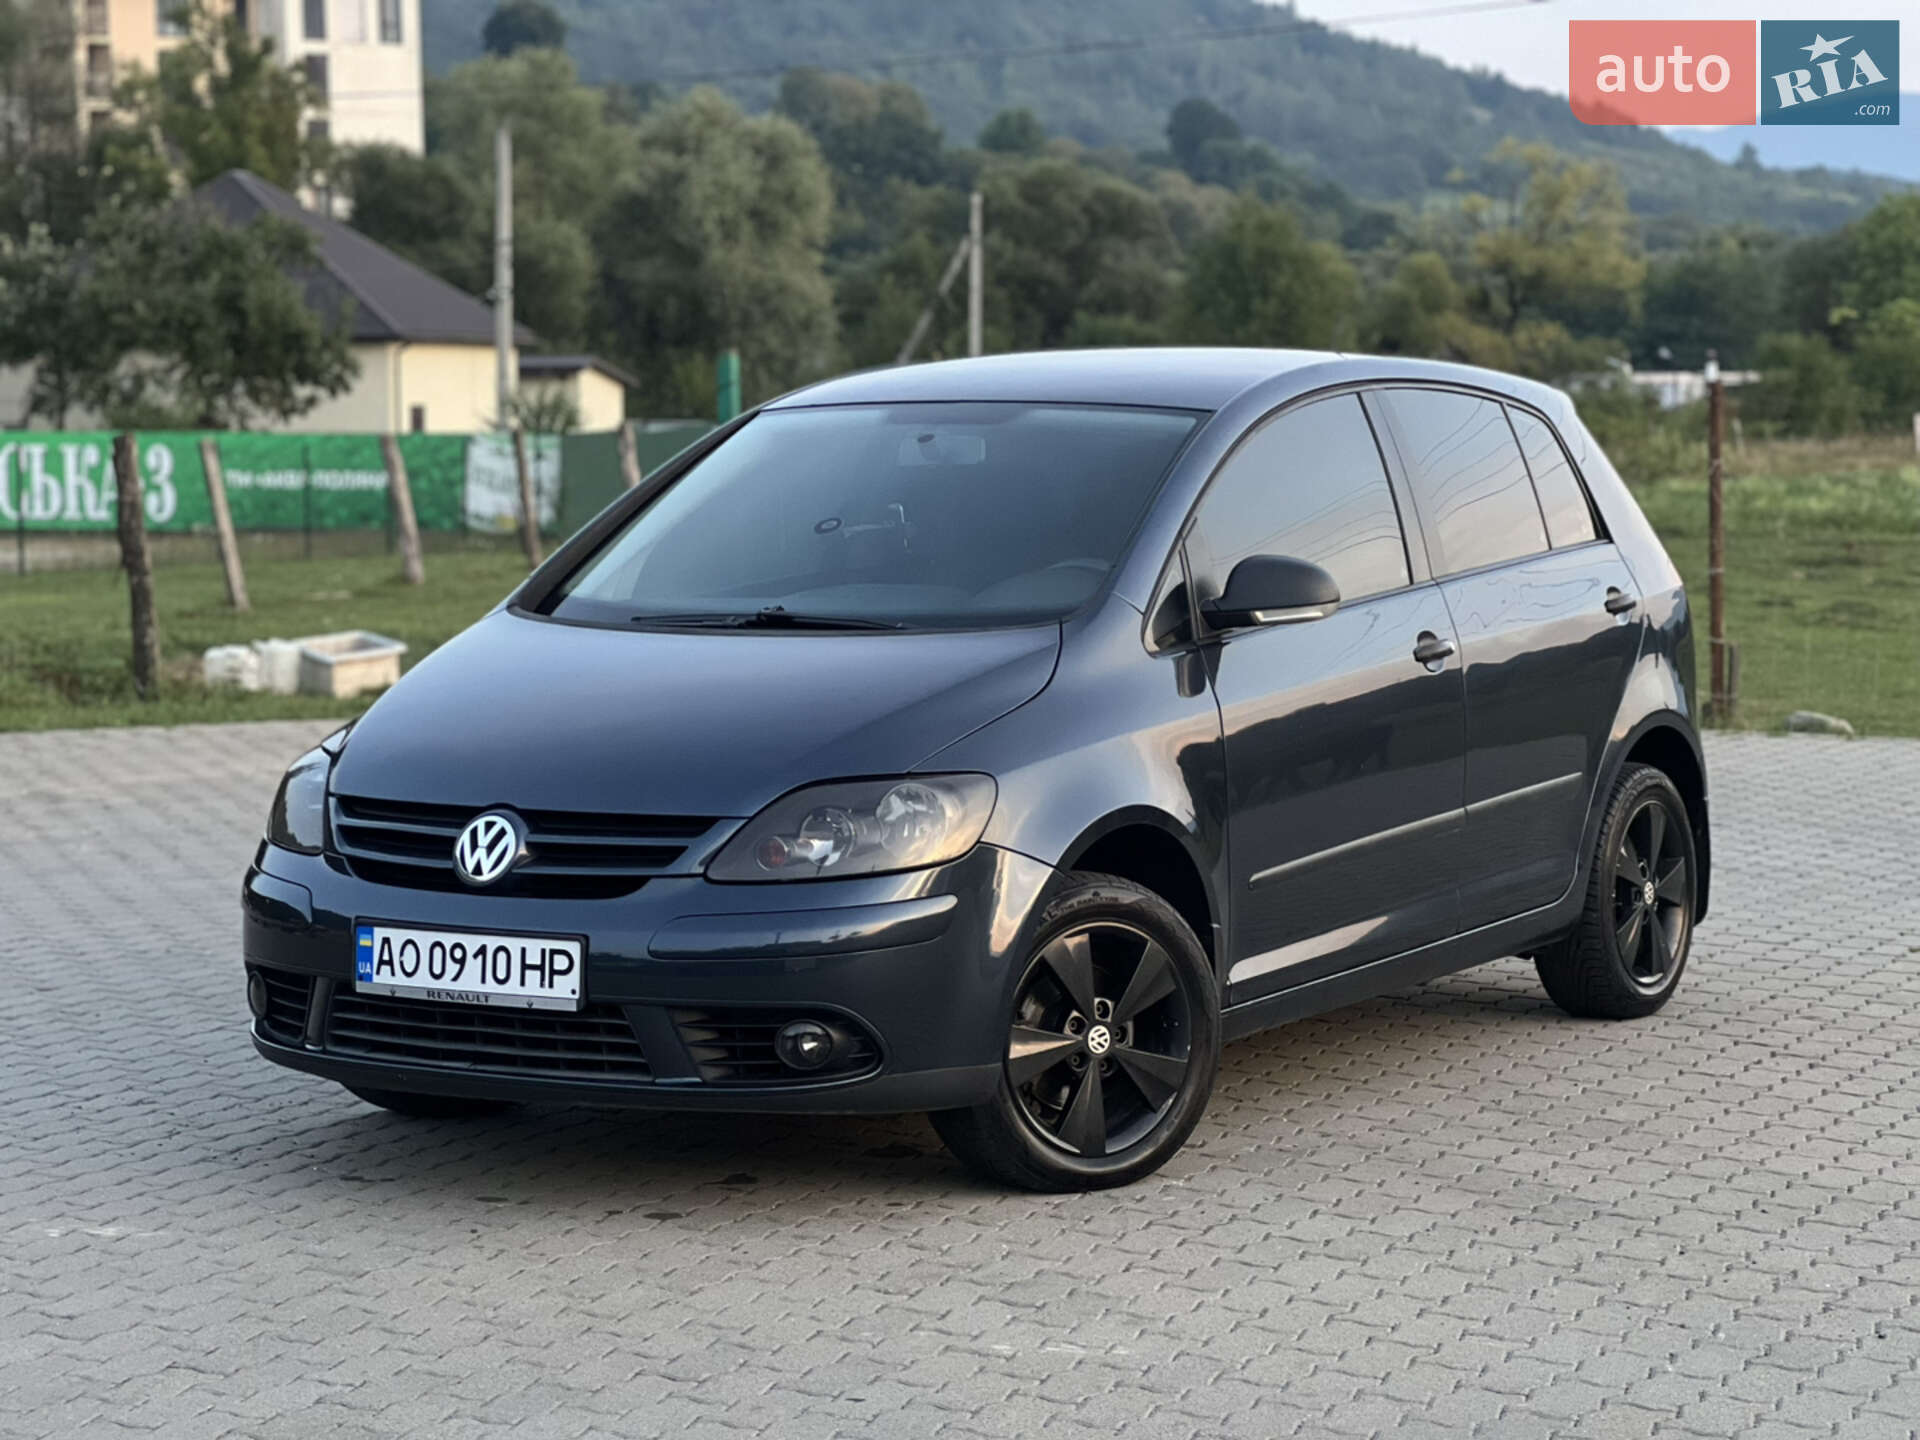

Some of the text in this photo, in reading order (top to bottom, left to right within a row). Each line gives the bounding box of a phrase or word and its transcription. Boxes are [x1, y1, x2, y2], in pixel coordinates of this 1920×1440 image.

[456, 815, 516, 881] VW
[359, 961, 372, 974] UA
[427, 990, 490, 1004] RENAULT
